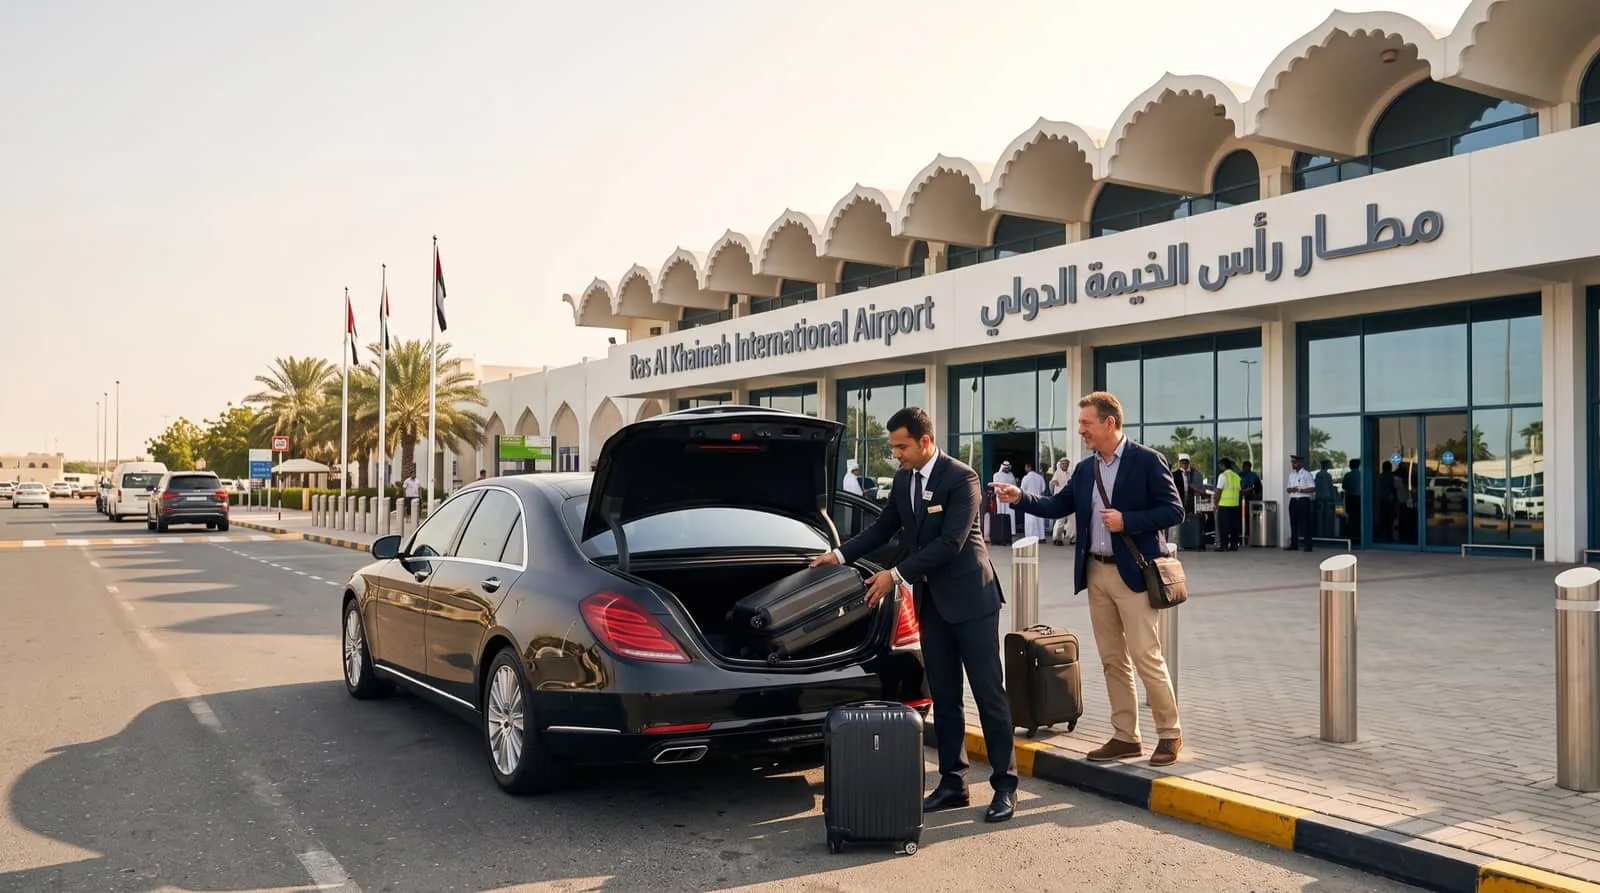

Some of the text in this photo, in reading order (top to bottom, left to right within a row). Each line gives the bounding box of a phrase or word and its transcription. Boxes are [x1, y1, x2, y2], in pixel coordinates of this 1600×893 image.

[980, 203, 1444, 336] مطار رأس الخيمة الدولي
[630, 295, 935, 380] Ras Al Khaimah International Airport
